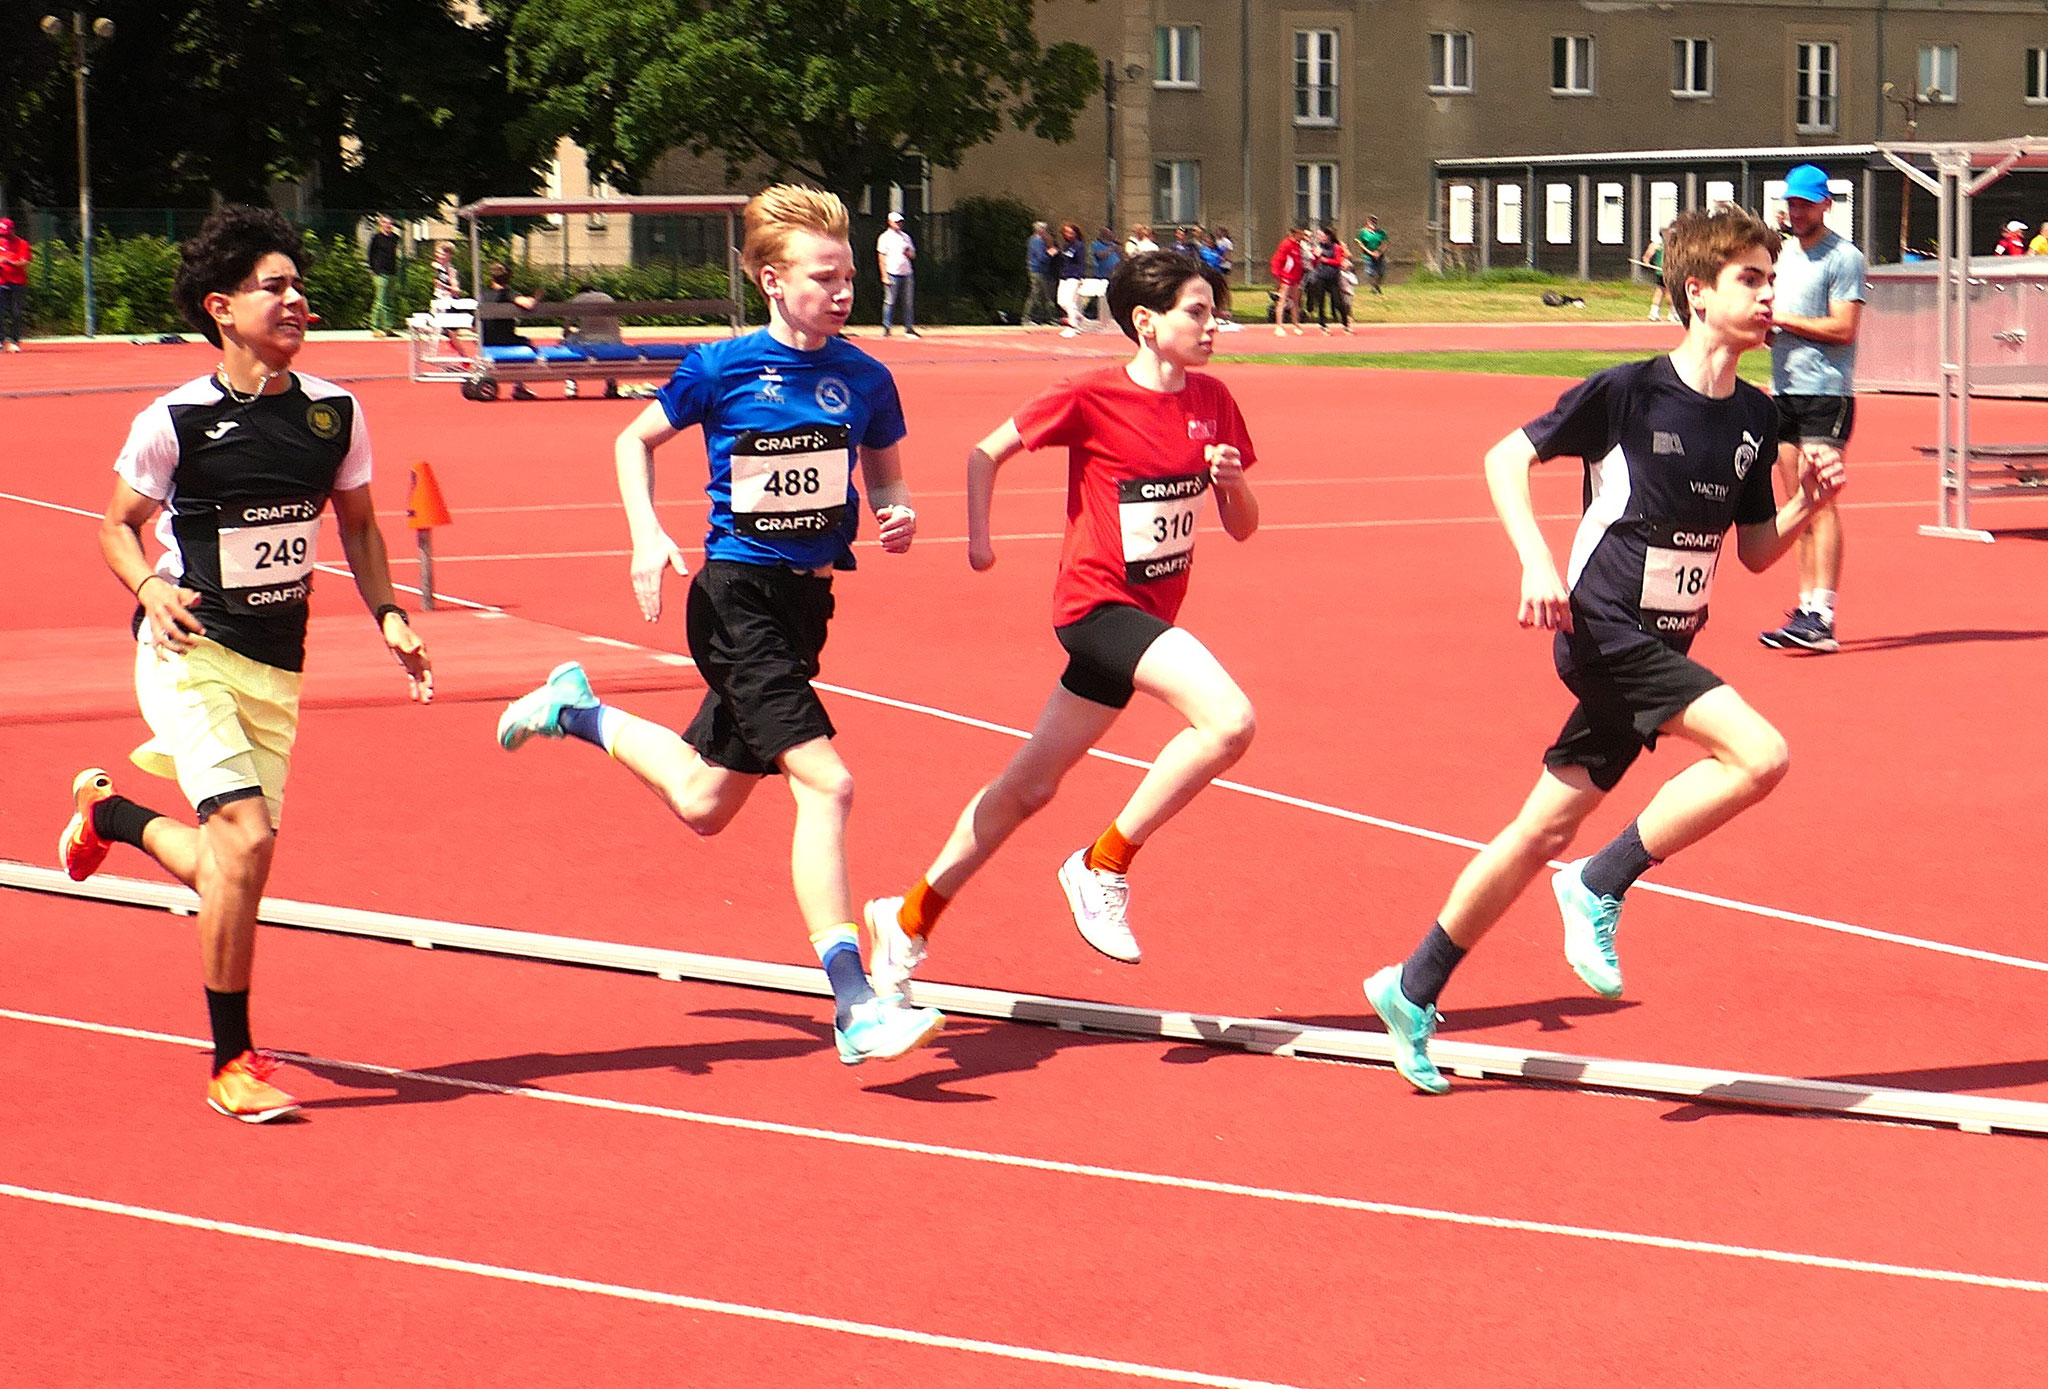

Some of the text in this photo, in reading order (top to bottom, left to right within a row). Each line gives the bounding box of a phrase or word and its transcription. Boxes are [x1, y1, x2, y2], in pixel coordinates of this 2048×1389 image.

[755, 434, 813, 452] CRAFT
[764, 467, 819, 497] 488
[1141, 482, 1192, 499] CRAFT
[243, 503, 303, 522] CRAFT
[755, 516, 816, 532] CRAFT
[1153, 510, 1194, 543] 310
[1673, 531, 1719, 547] CRAFT
[254, 537, 307, 571] 249
[1145, 560, 1184, 578] CRAFT
[247, 587, 299, 606] CRAFT
